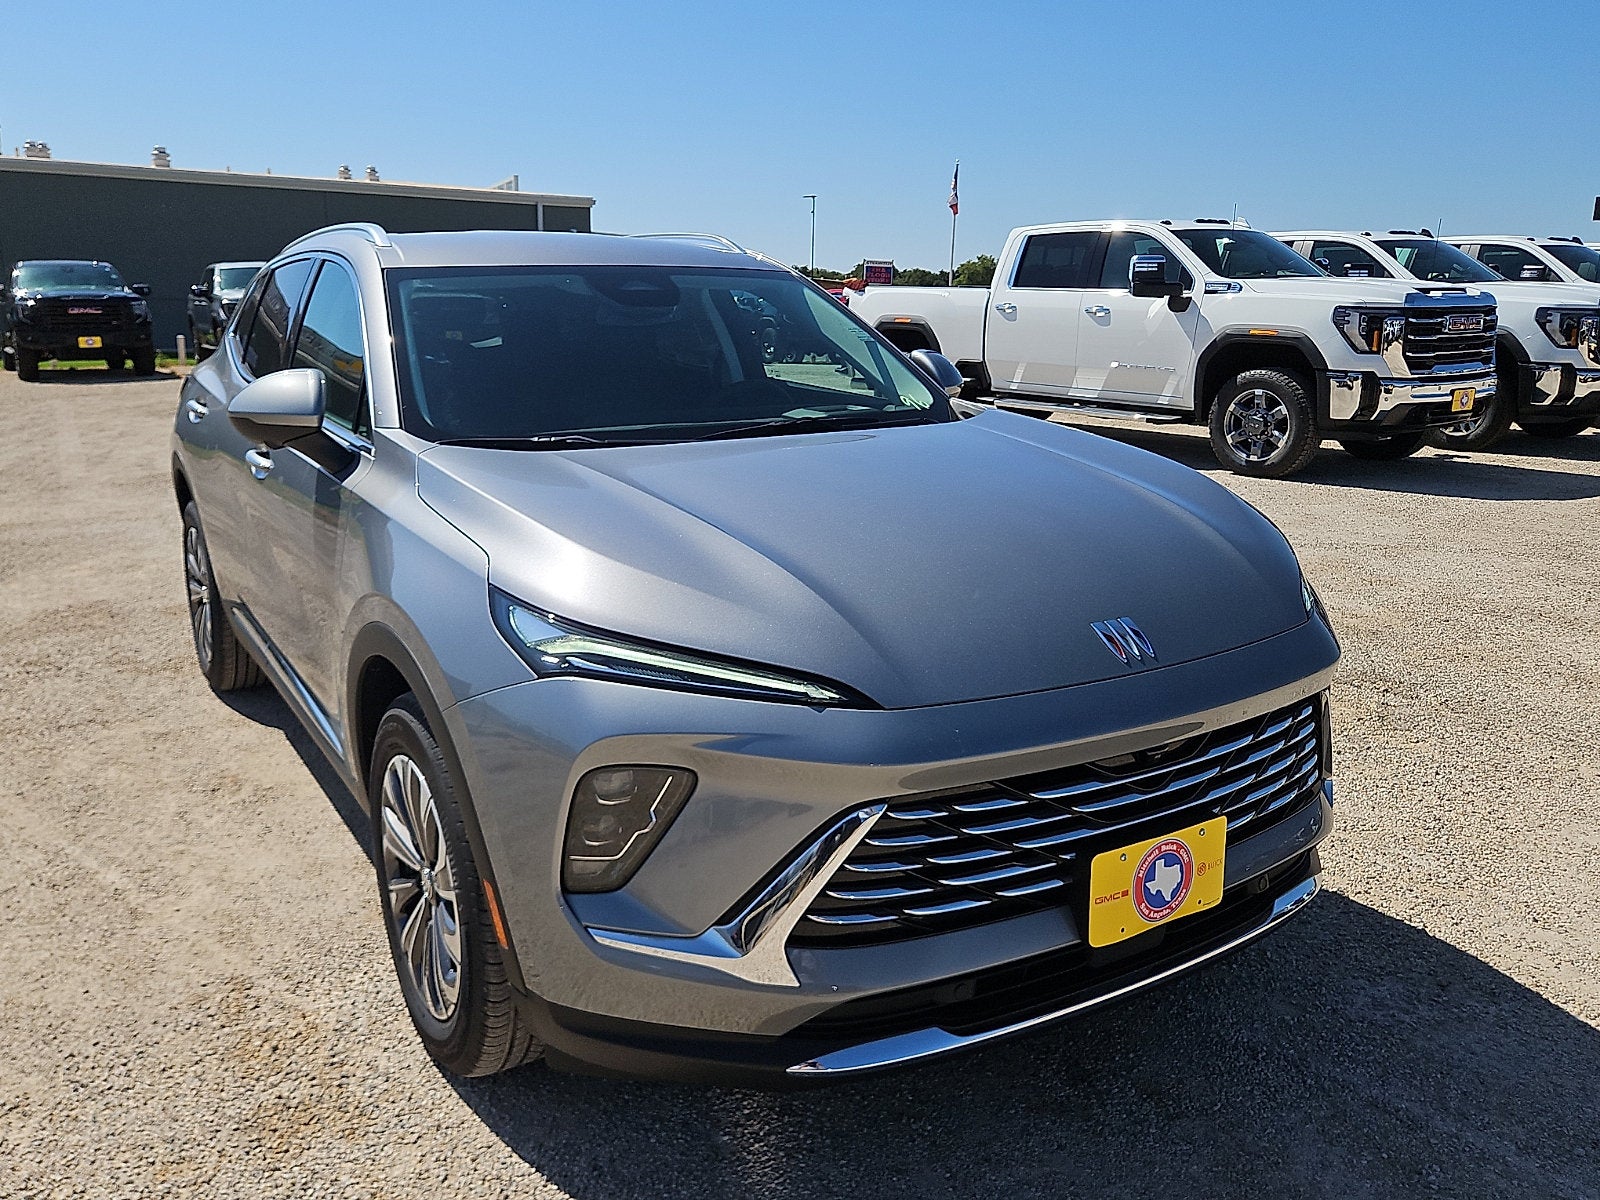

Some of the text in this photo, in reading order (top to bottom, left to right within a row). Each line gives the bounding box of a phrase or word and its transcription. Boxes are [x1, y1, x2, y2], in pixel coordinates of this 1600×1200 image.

[1450, 316, 1482, 329] GMC
[1137, 843, 1190, 878] Mitchell Buick GMC
[1094, 891, 1121, 905] GMC
[1140, 902, 1150, 916] San
[1171, 888, 1187, 909] Texas
